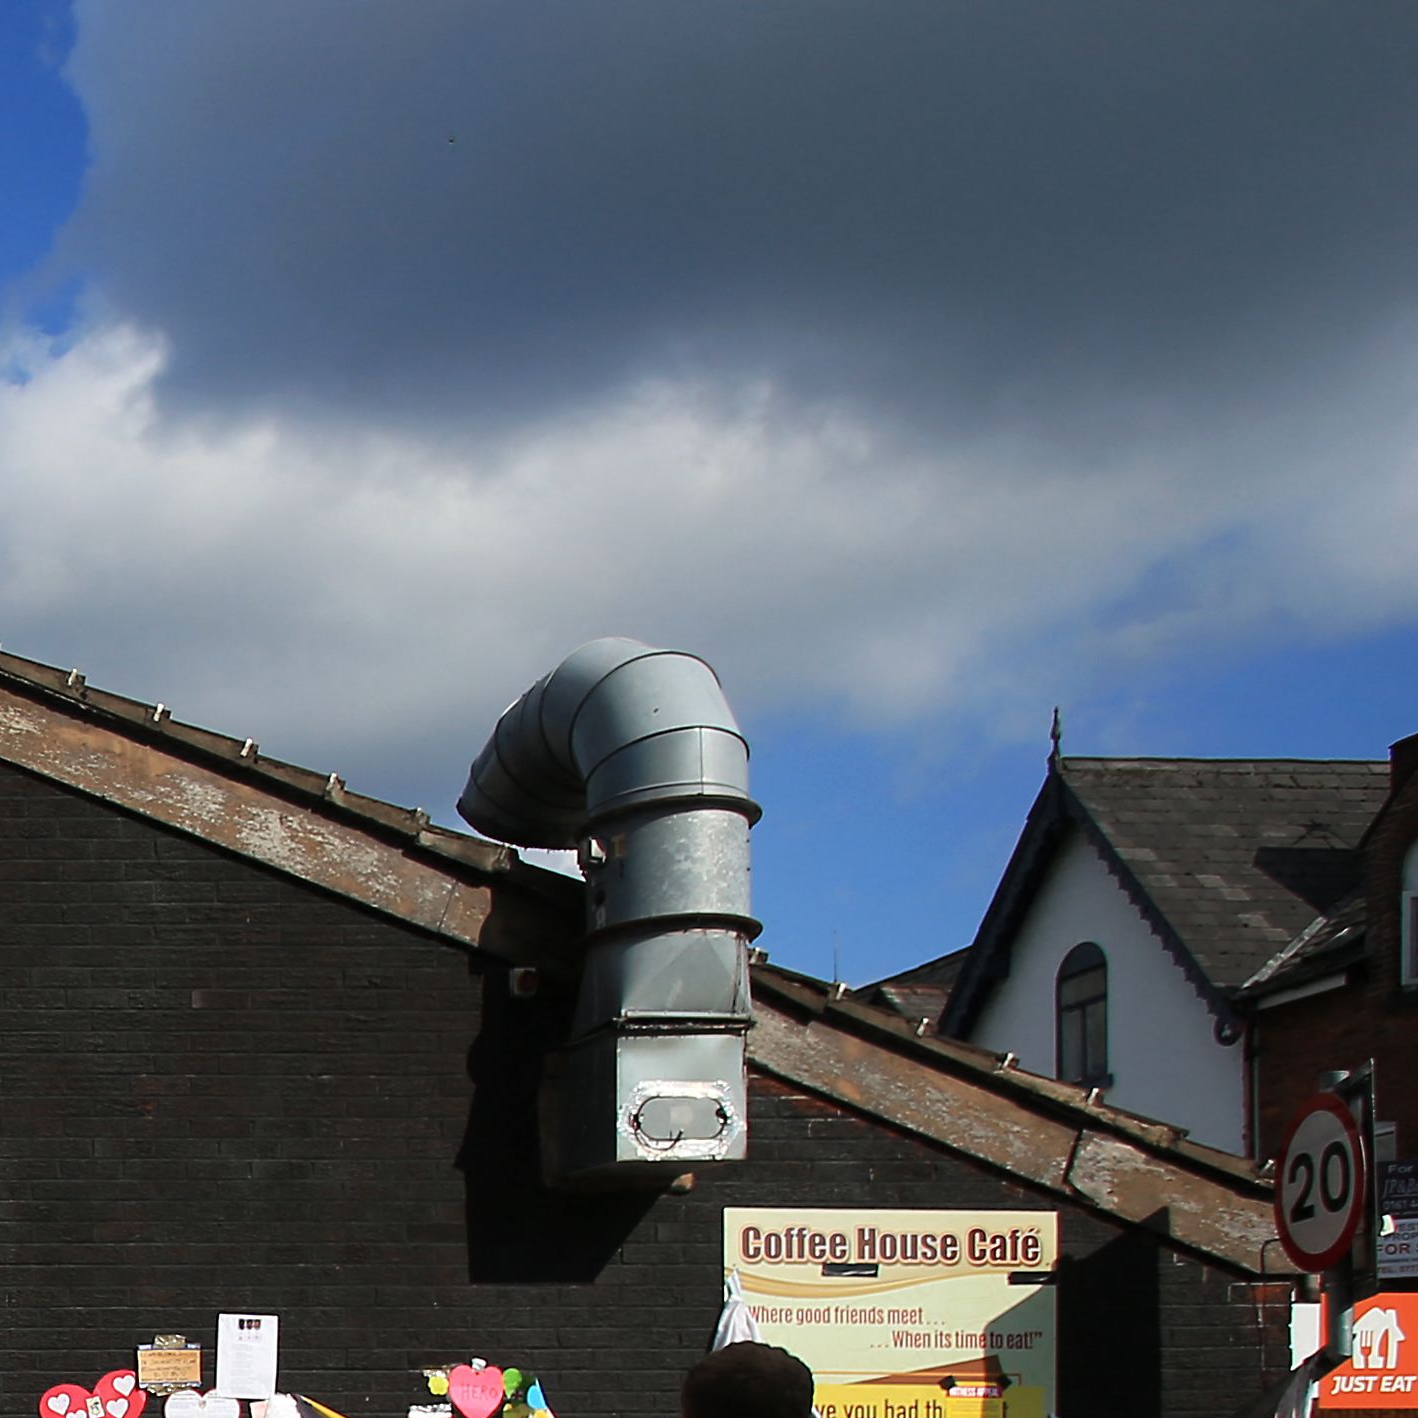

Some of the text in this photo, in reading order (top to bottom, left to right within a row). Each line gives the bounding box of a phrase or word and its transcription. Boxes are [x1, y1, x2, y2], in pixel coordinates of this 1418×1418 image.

[1289, 1141, 1350, 1223] 20
[741, 1225, 1041, 1266] Coffee House Café
[797, 1306, 830, 1326] good
[834, 1305, 884, 1325] friends
[935, 1330, 951, 1349] its
[954, 1330, 987, 1350] time
[989, 1331, 1004, 1350] to
[460, 1383, 498, 1400] HERO
[1331, 1375, 1417, 1395] JUST EAT
